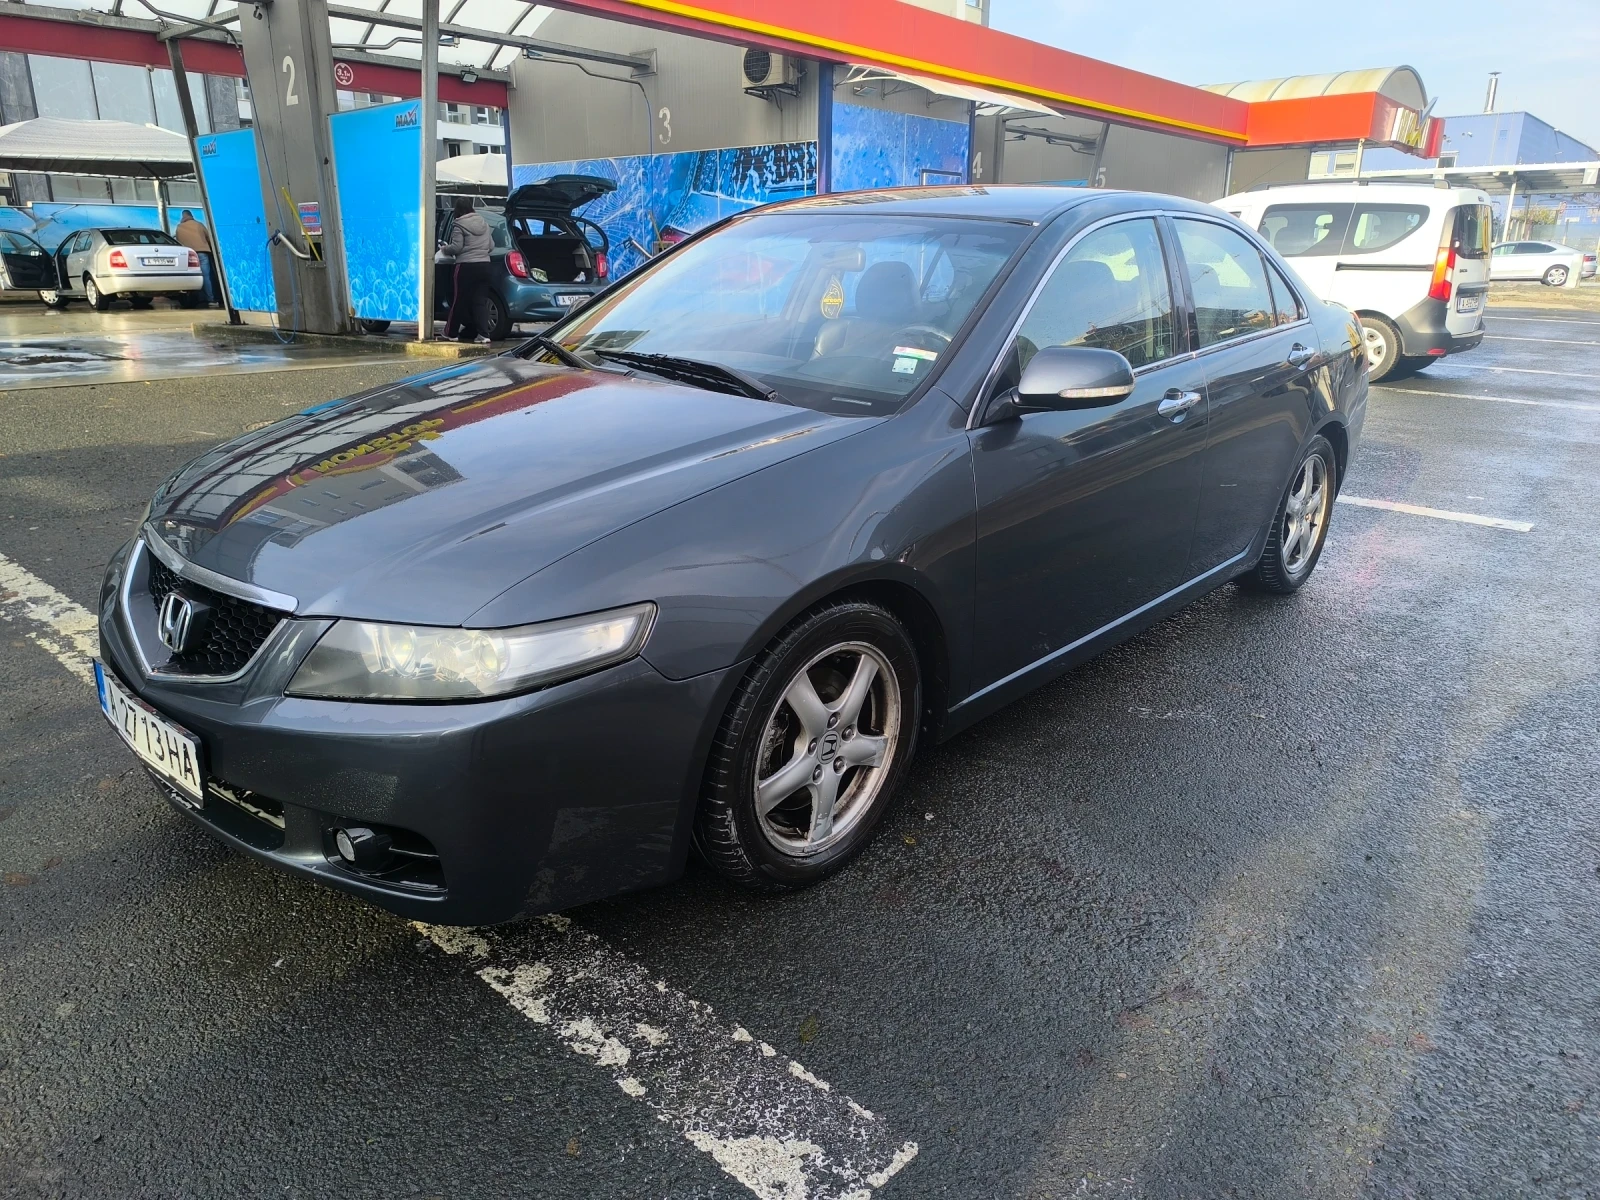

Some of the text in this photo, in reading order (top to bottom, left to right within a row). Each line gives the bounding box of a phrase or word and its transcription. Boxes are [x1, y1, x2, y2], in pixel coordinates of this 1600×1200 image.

[282, 55, 299, 106] 2
[658, 106, 671, 145] 3
[972, 151, 983, 179] 4
[1095, 167, 1106, 188] 5
[108, 682, 119, 722] A
